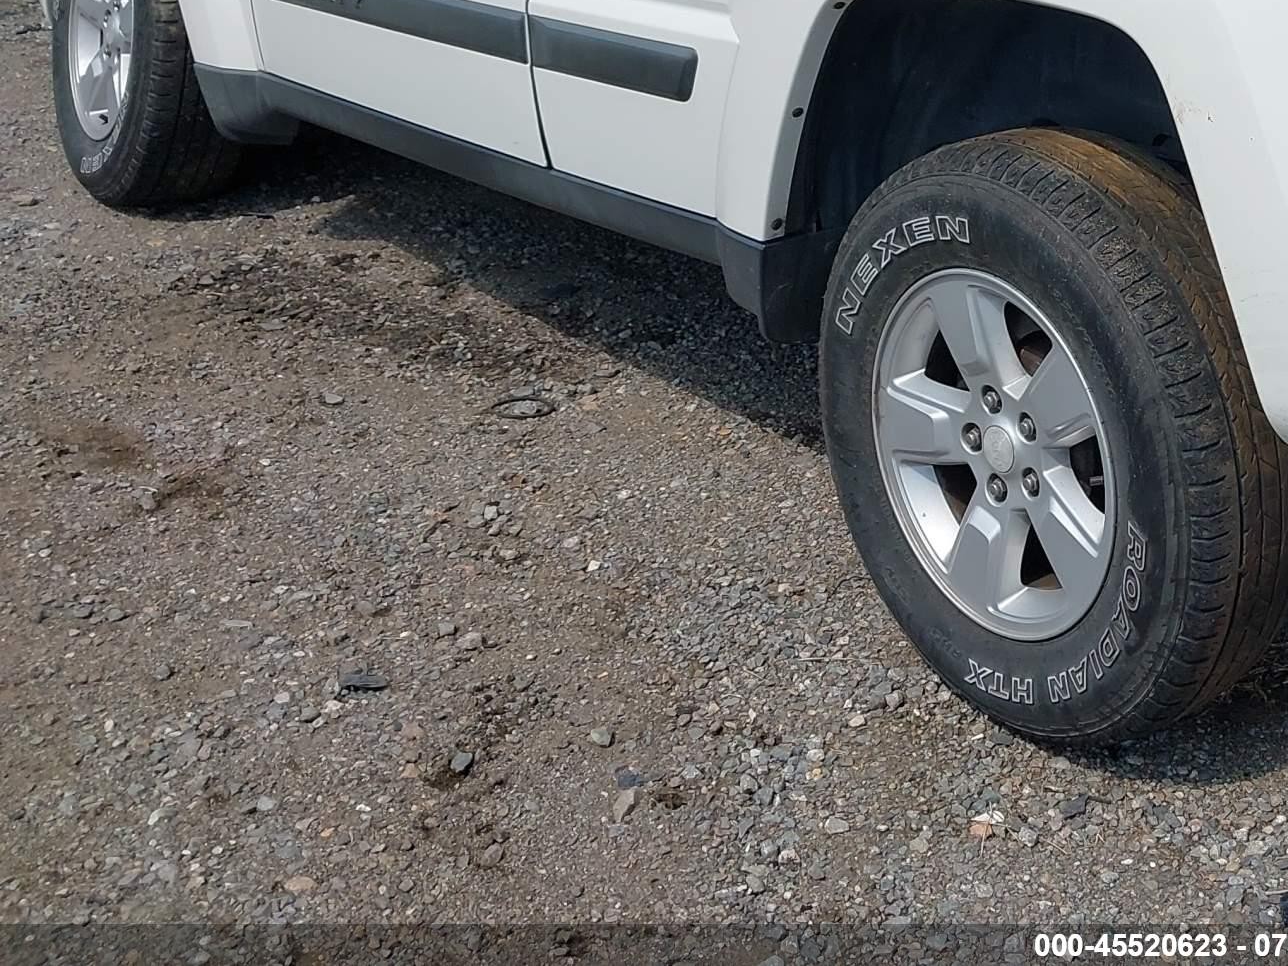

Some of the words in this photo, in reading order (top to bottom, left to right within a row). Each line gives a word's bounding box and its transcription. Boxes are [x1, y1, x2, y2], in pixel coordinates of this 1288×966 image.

[835, 215, 970, 335] NEXEN
[1047, 520, 1149, 703] ROADIAN
[964, 658, 1034, 705] HTX
